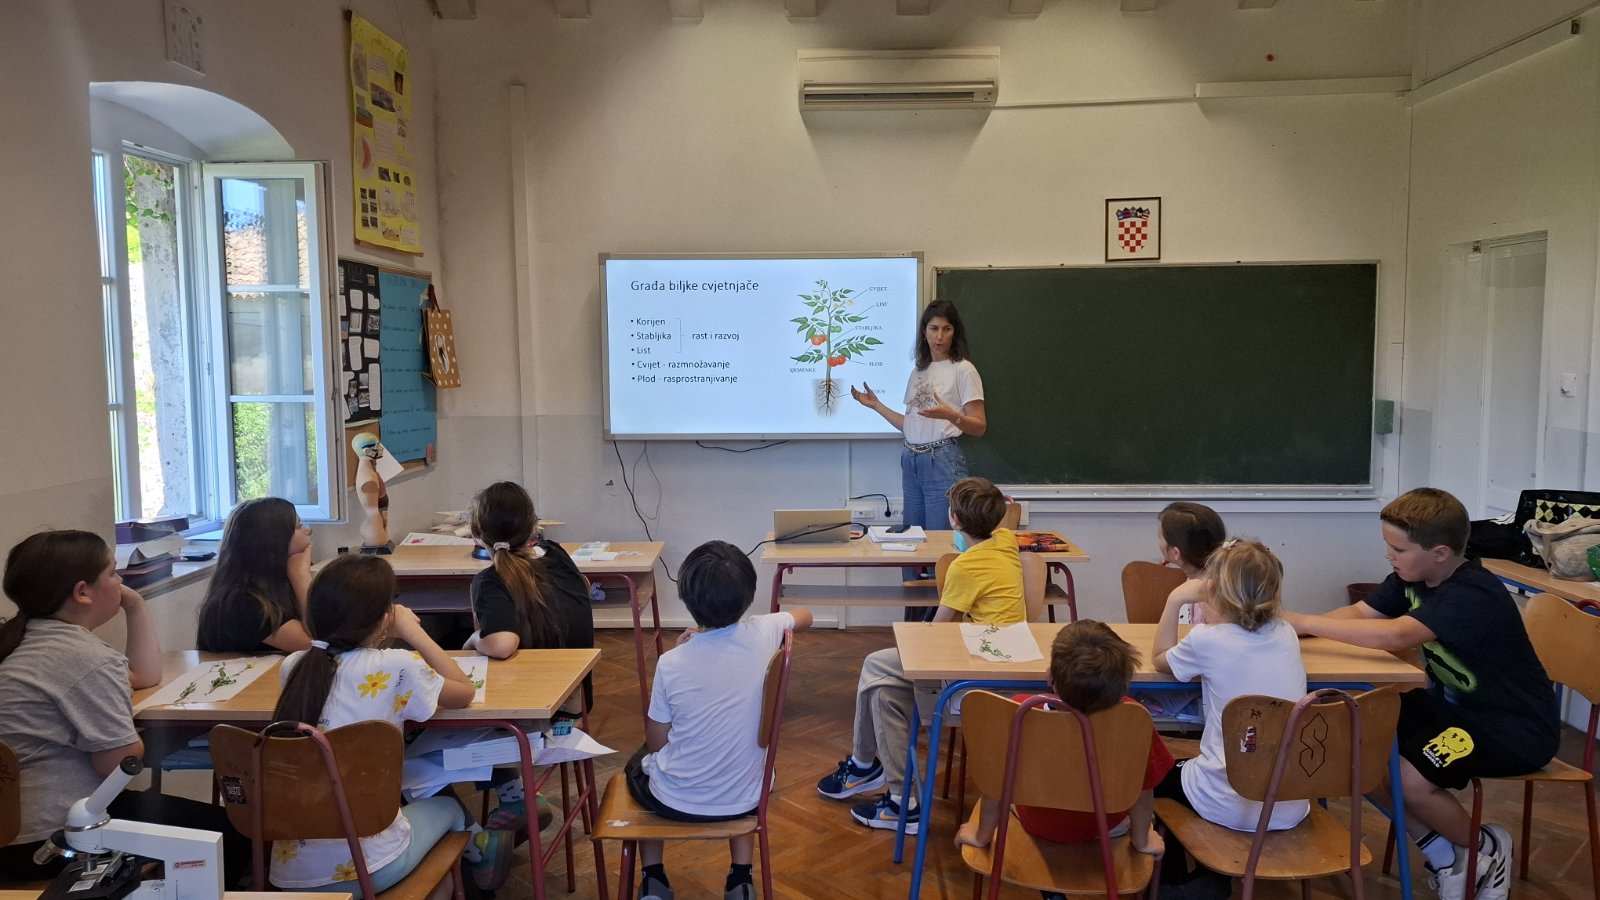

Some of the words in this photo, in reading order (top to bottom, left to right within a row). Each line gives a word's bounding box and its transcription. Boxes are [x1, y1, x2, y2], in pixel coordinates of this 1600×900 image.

[630, 280, 665, 291] Građa
[669, 280, 698, 293] biljke
[701, 280, 759, 293] cvjetnjače
[636, 318, 666, 327] Korijen
[636, 331, 672, 341] Stabljika
[692, 332, 708, 340] rast
[714, 332, 740, 341] razvoj
[636, 346, 651, 355] List
[636, 360, 661, 370] Cvijet
[668, 360, 730, 370] razmnožavanje
[637, 374, 656, 383] Plod
[663, 374, 738, 385] rasprostranjivanje
